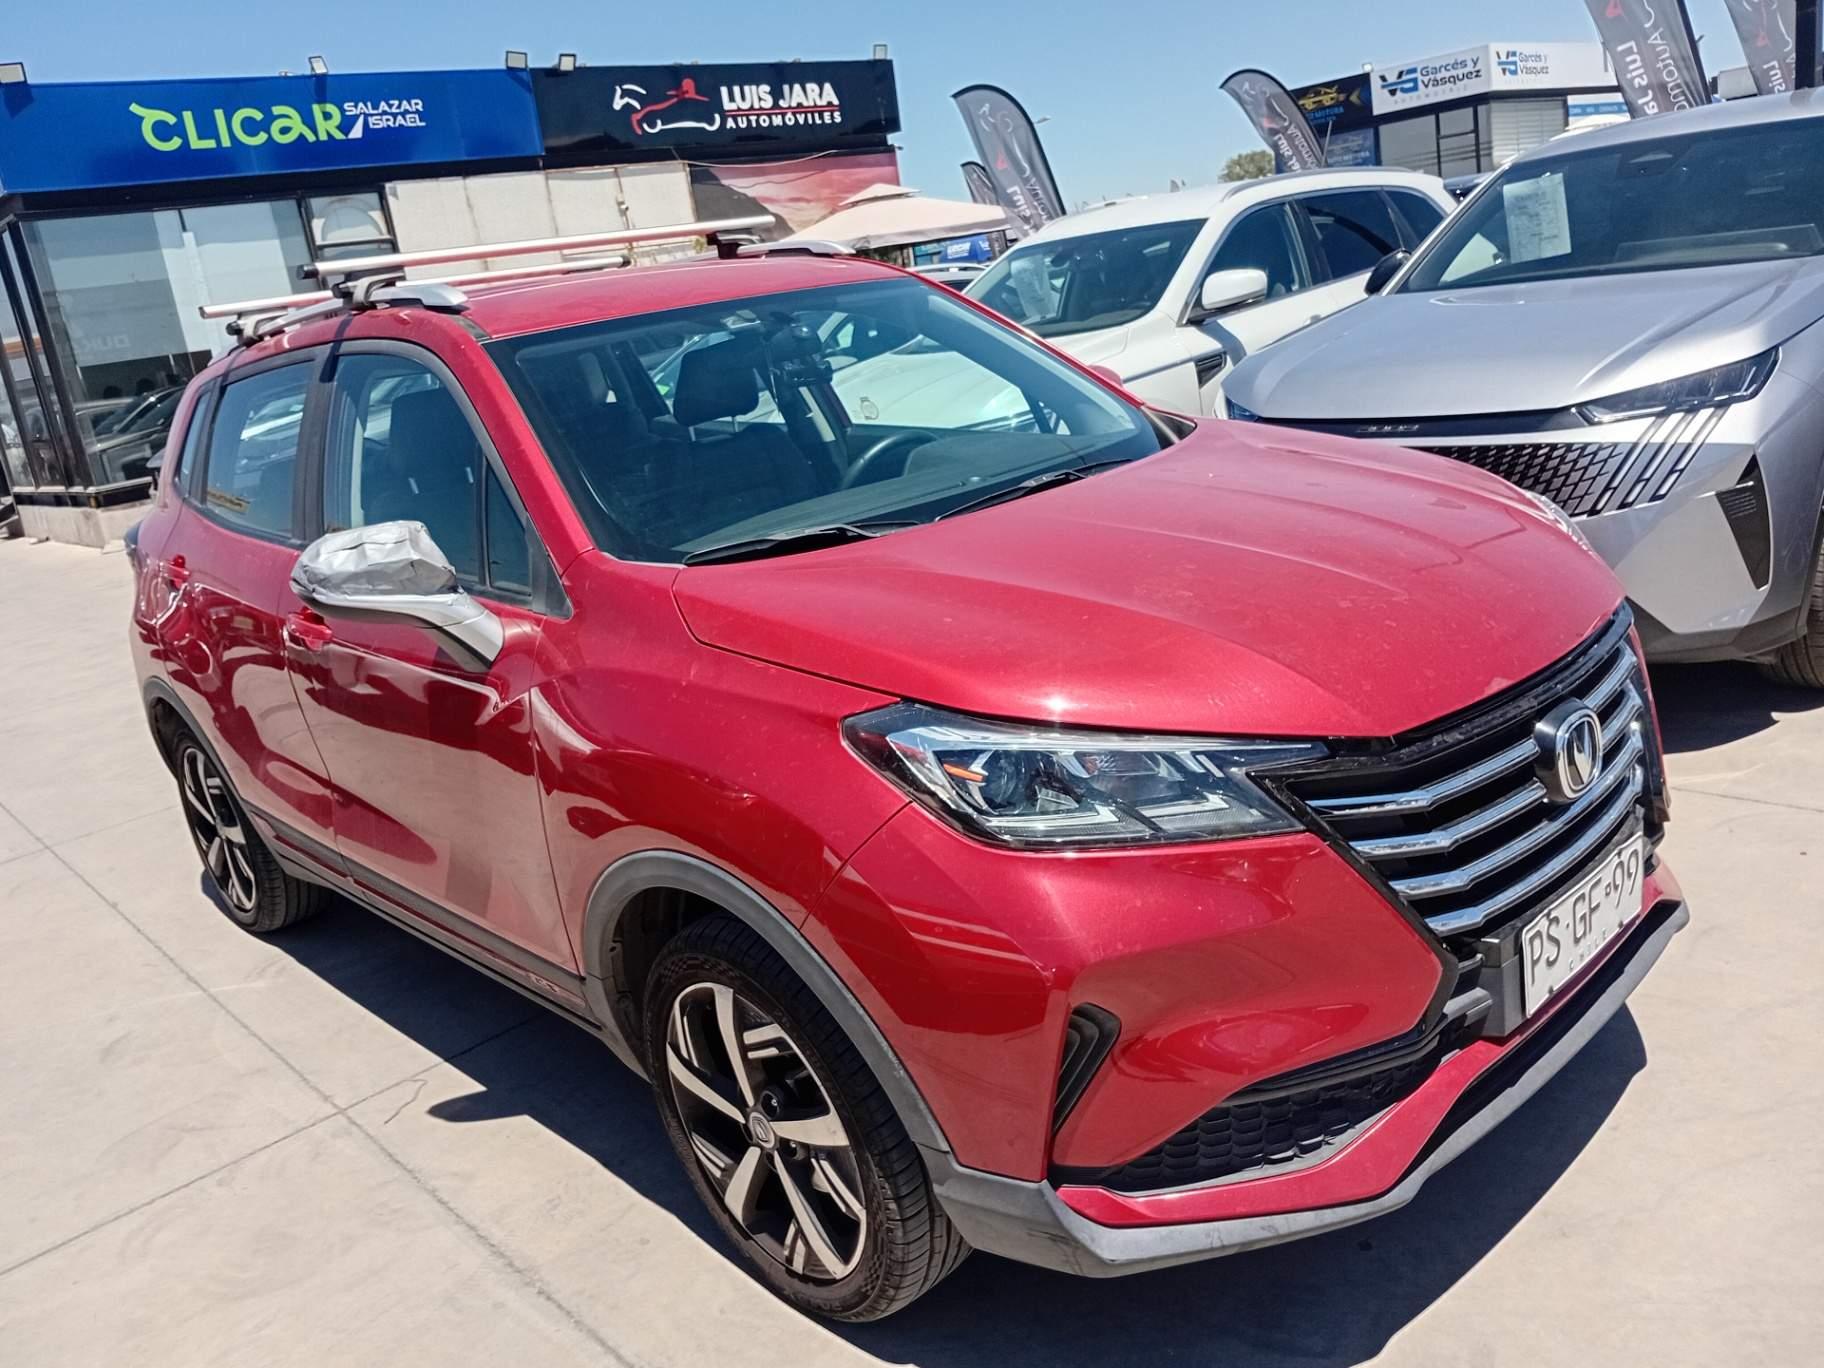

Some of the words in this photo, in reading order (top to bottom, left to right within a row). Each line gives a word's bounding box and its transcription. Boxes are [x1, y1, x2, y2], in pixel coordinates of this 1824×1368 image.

[1419, 59, 1468, 77] Garcés
[1471, 56, 1480, 70] y
[1420, 69, 1482, 89] Vásquez
[719, 84, 773, 110] LUIS
[778, 82, 840, 108] JARA
[343, 99, 424, 115] SALAZAR
[368, 113, 426, 129] ISRAEL
[726, 111, 842, 128] AUTOMÓVILES
